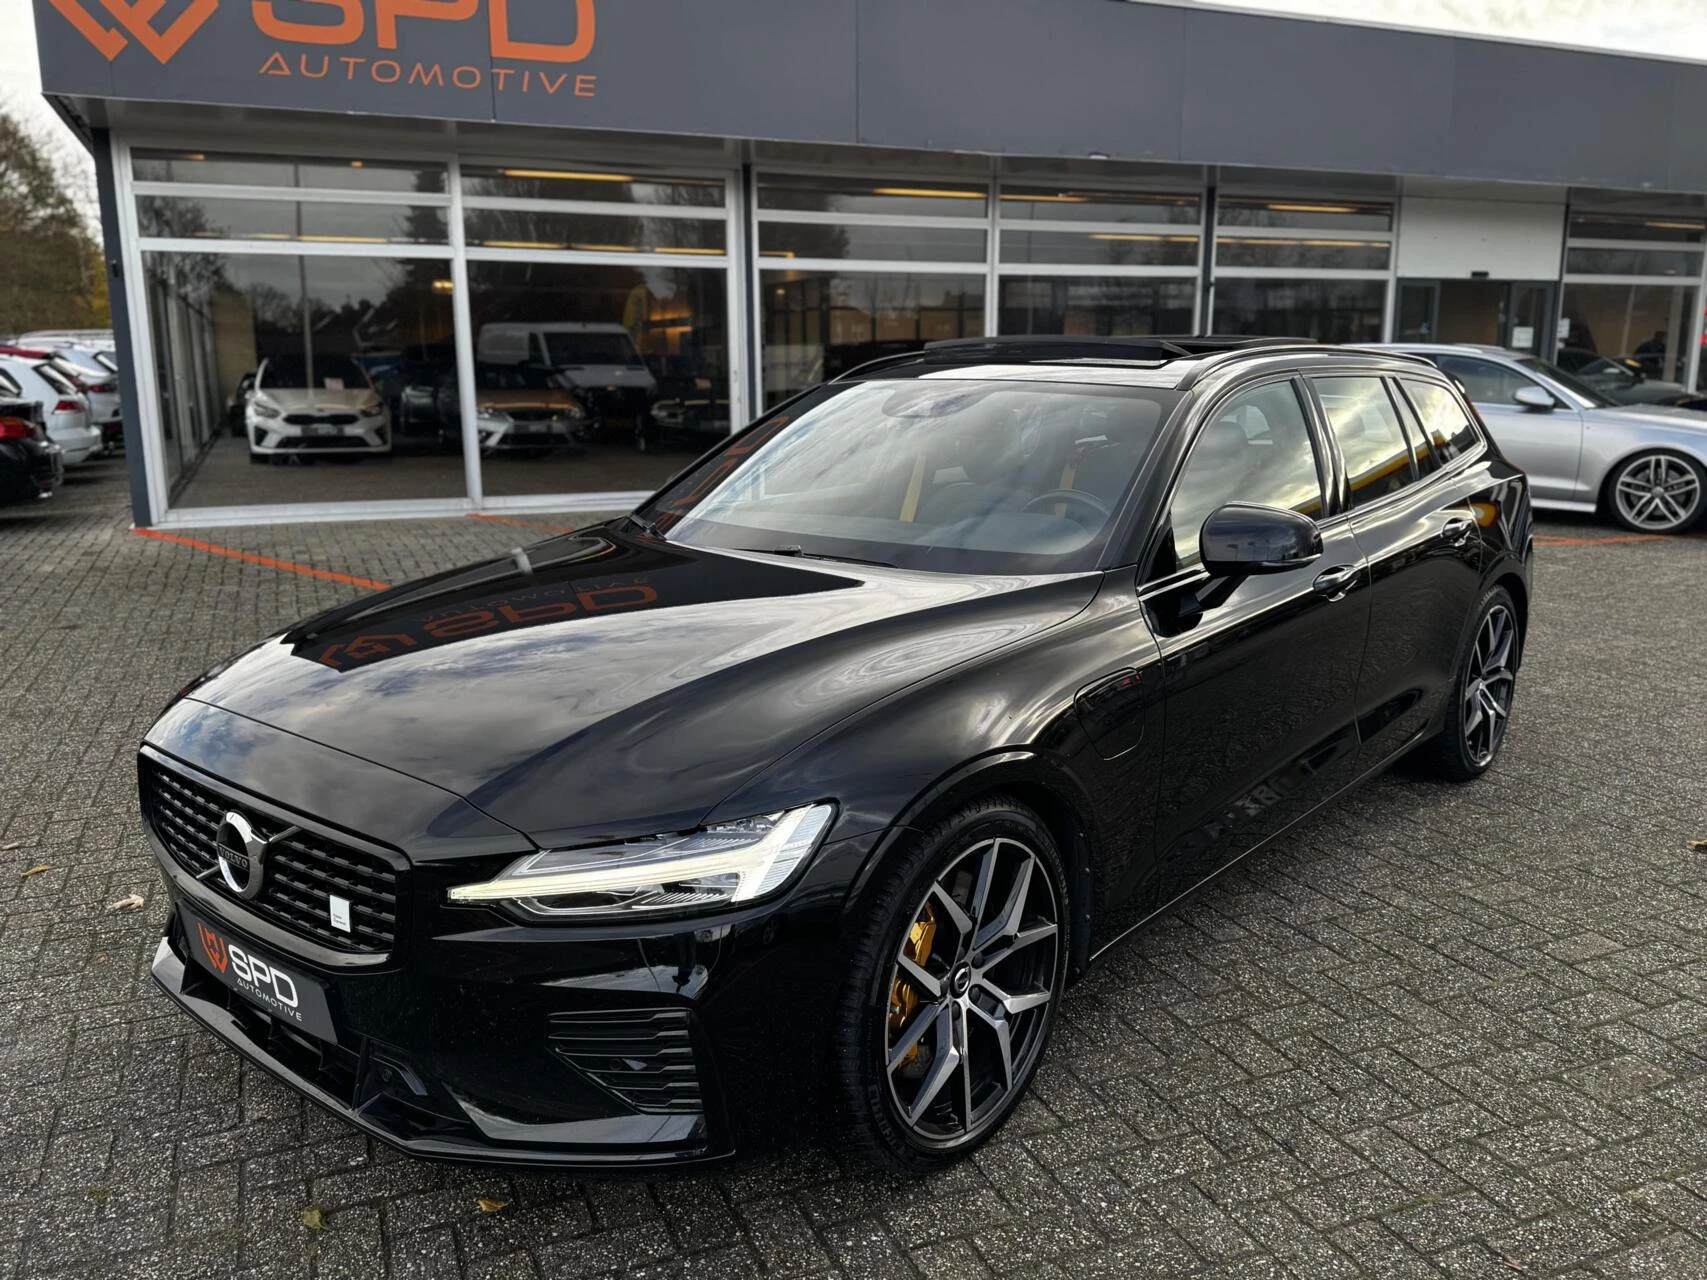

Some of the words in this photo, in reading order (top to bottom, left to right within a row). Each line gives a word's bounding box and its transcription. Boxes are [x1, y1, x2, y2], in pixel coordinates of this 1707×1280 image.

[258, 51, 598, 98] AUTOMOTIVE
[218, 847, 248, 868] VOLVO
[228, 944, 299, 1008] SPD
[237, 978, 303, 1022] AUTOMOTIVE
